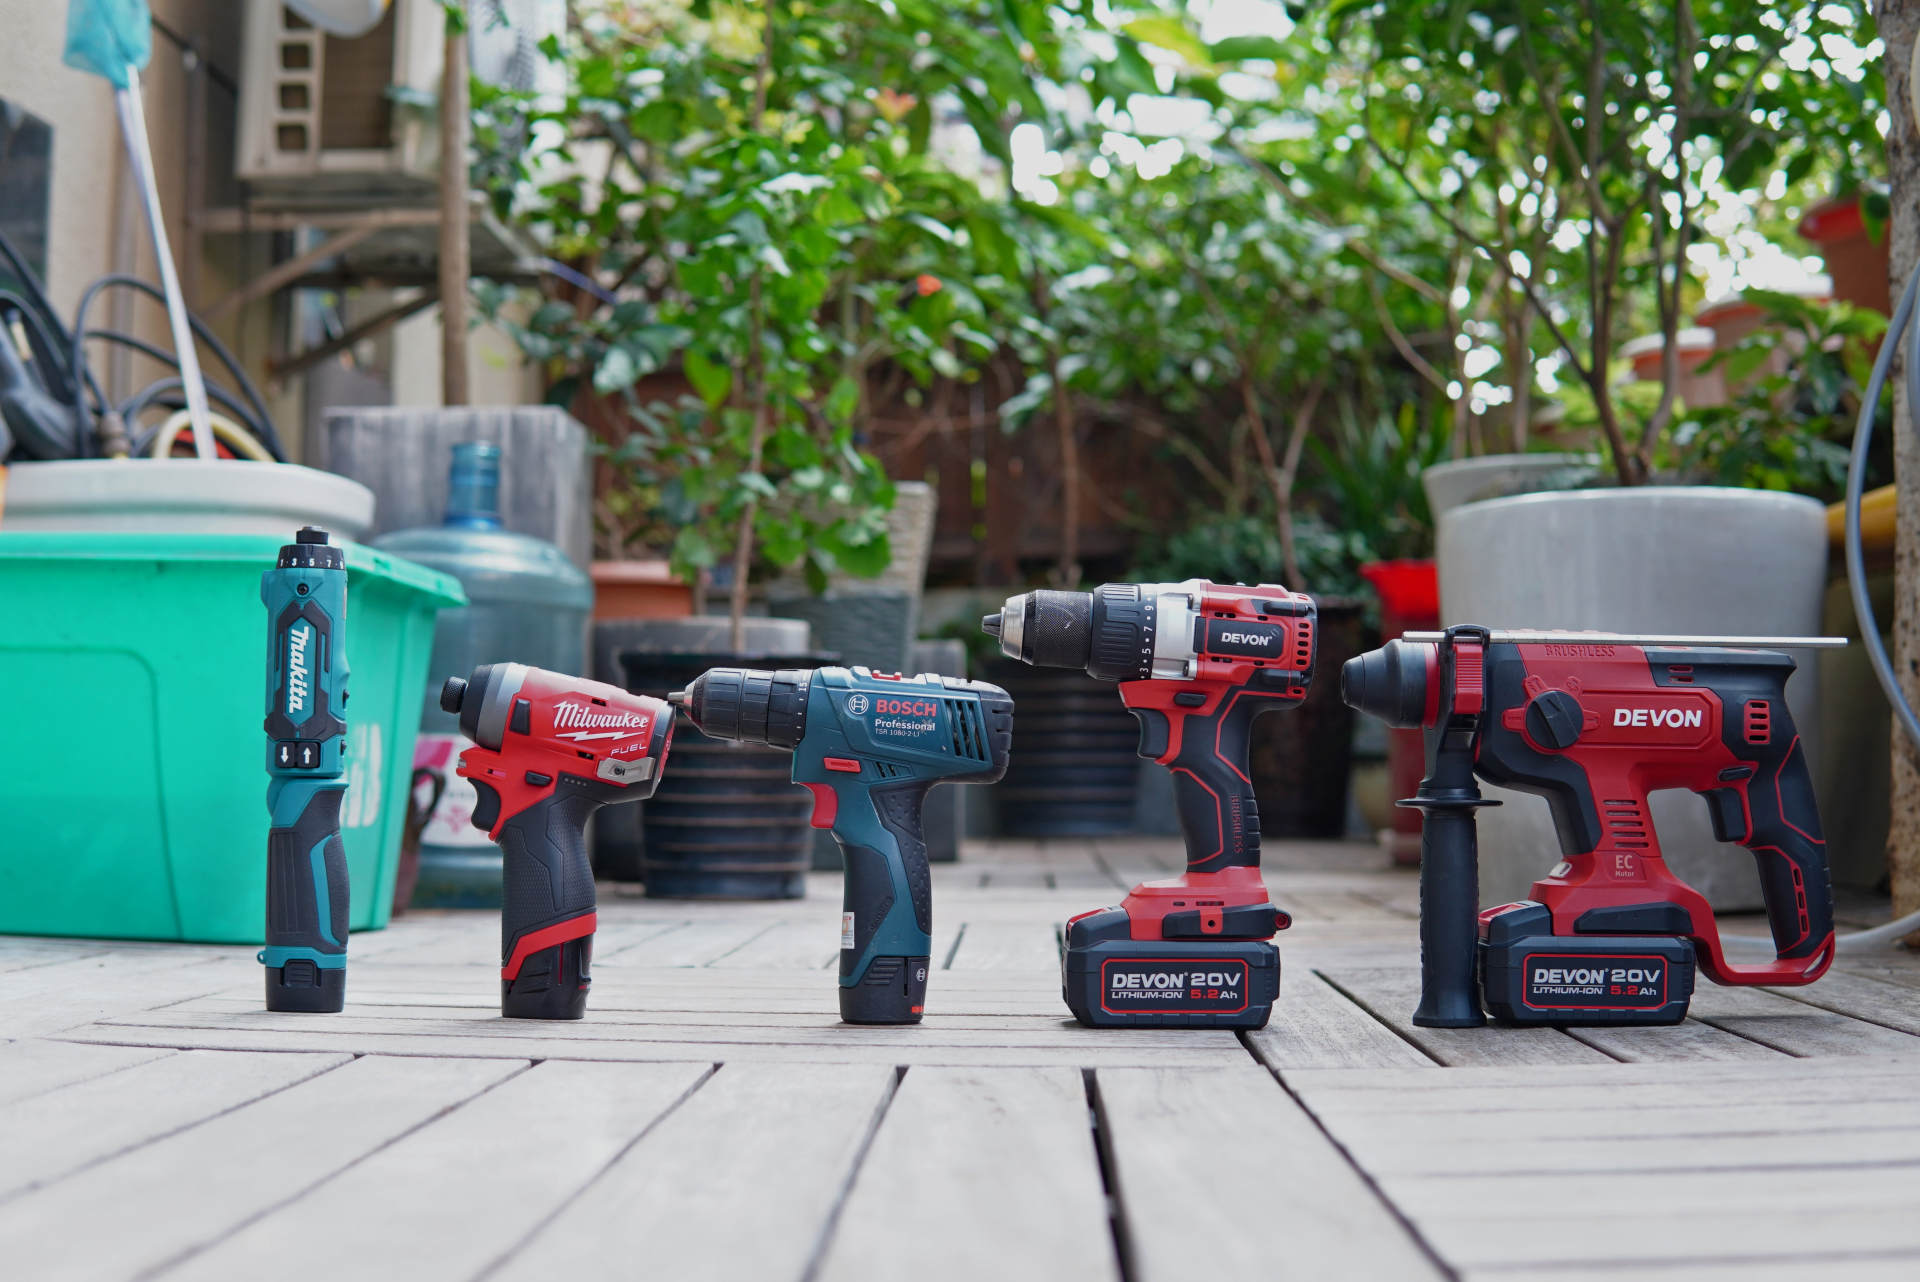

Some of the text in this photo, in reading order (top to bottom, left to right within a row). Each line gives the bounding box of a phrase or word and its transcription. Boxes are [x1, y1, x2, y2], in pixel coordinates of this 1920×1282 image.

[291, 558, 297, 567] 3
[309, 558, 315, 567] 5
[326, 560, 332, 568] 7
[1221, 632, 1269, 646] DEVON
[1544, 644, 1616, 657] BRUSHLESS
[553, 700, 649, 728] Milwaukee
[876, 699, 937, 717] BOSCH
[875, 719, 936, 731] Professional
[1613, 708, 1702, 728] DEVON
[610, 743, 647, 757] FUEL
[1615, 854, 1633, 869] EC
[1190, 972, 1241, 986] 20V
[1611, 969, 1661, 983] 20V
[1111, 991, 1183, 999] LITHIUM-ION
[1533, 986, 1603, 995] LITHIUM-ION
